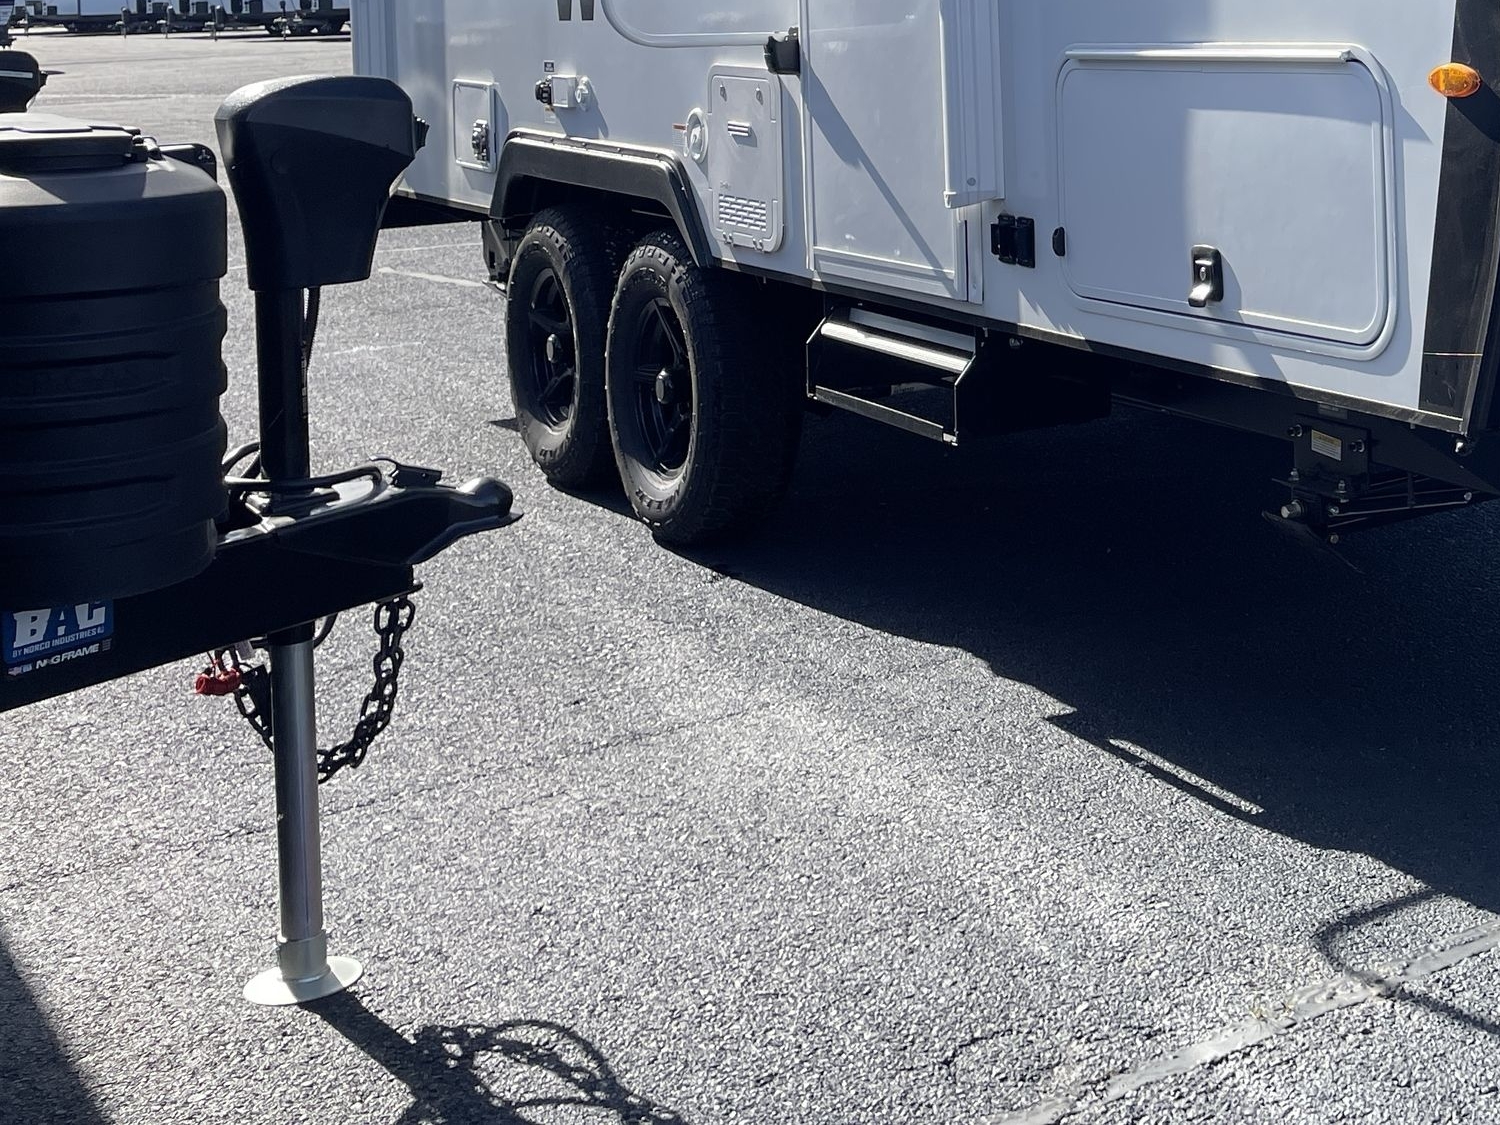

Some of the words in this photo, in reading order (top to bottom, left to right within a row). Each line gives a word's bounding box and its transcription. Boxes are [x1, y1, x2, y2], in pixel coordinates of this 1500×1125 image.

[12, 648, 23, 658] BY
[23, 640, 51, 655] NORCO
[52, 626, 97, 647] INDUSTRIES
